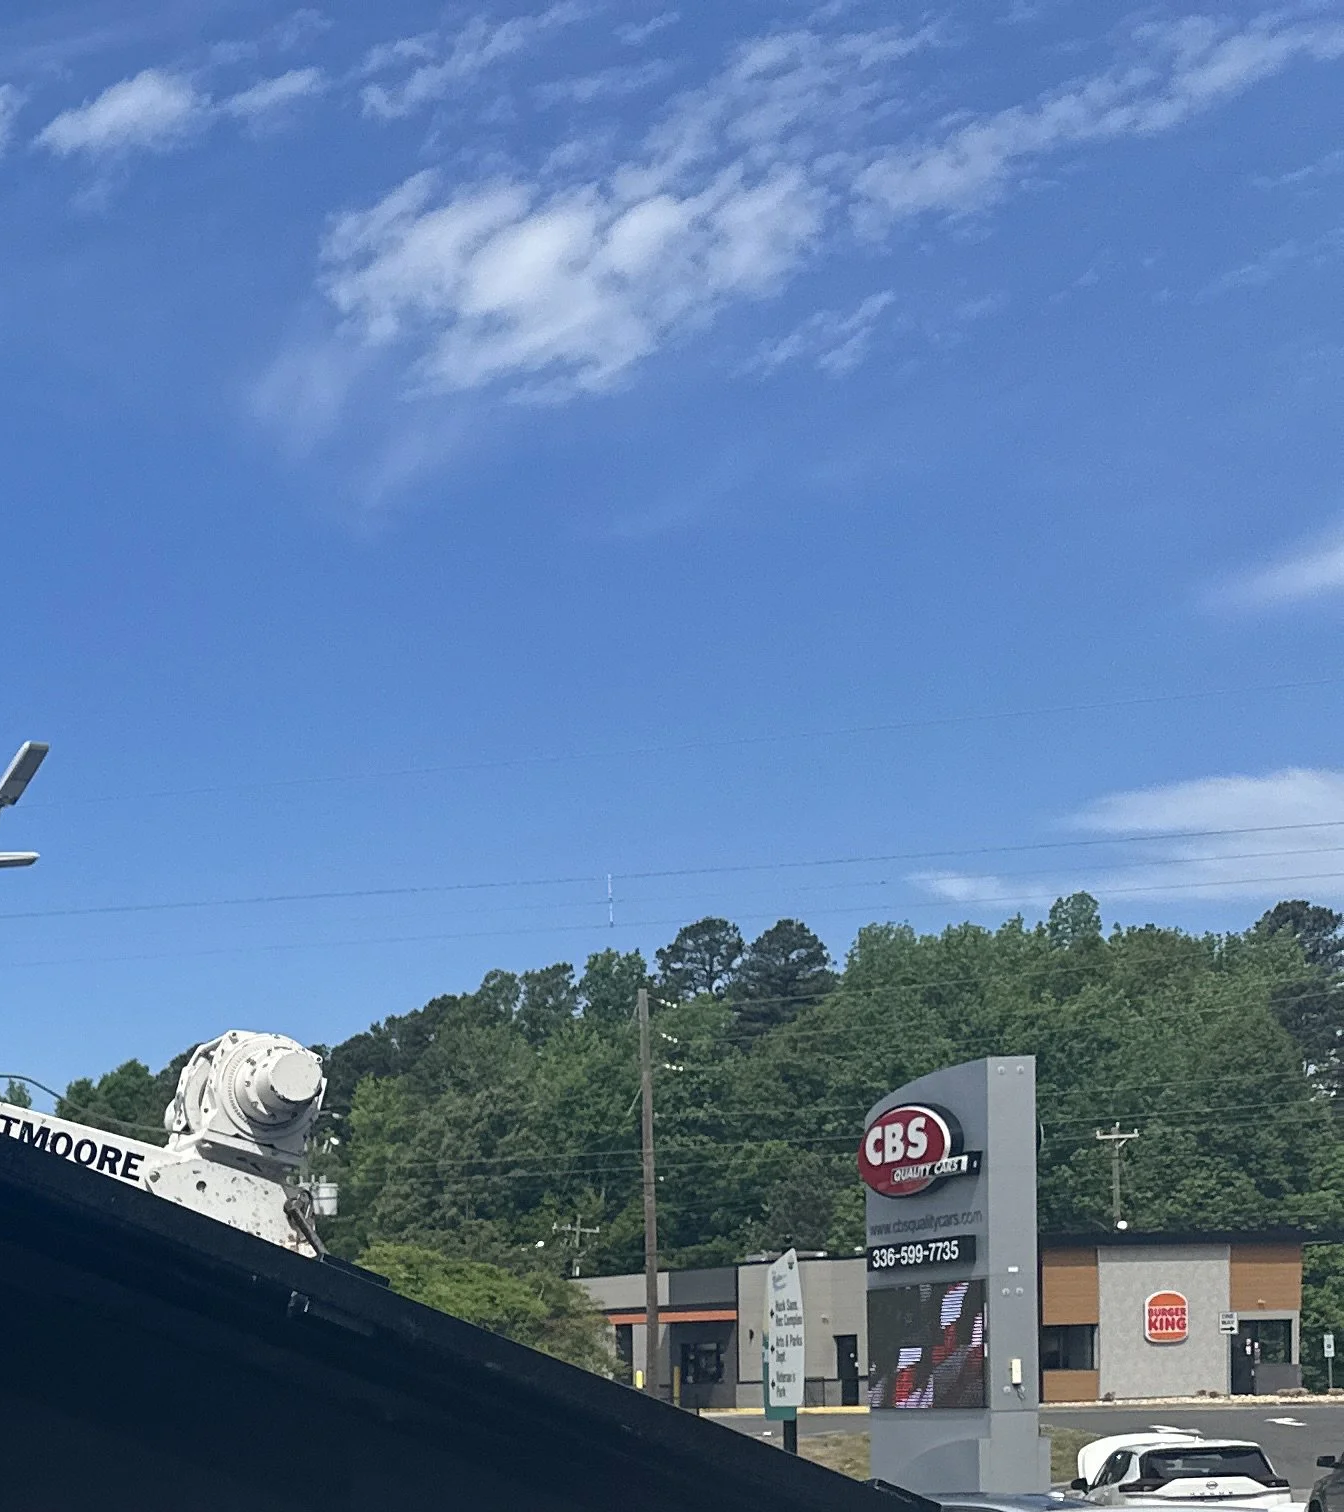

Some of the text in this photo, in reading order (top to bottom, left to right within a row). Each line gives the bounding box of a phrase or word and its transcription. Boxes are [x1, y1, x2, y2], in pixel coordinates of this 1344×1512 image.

[865, 1116, 928, 1166] CBS
[894, 1159, 958, 1181] QUALITY CARS
[871, 1210, 982, 1236] www.cbsqualitycars.com
[872, 1240, 959, 1268] 336-599-7735
[1148, 1307, 1186, 1317] BURGER
[1148, 1318, 1186, 1331] KING
